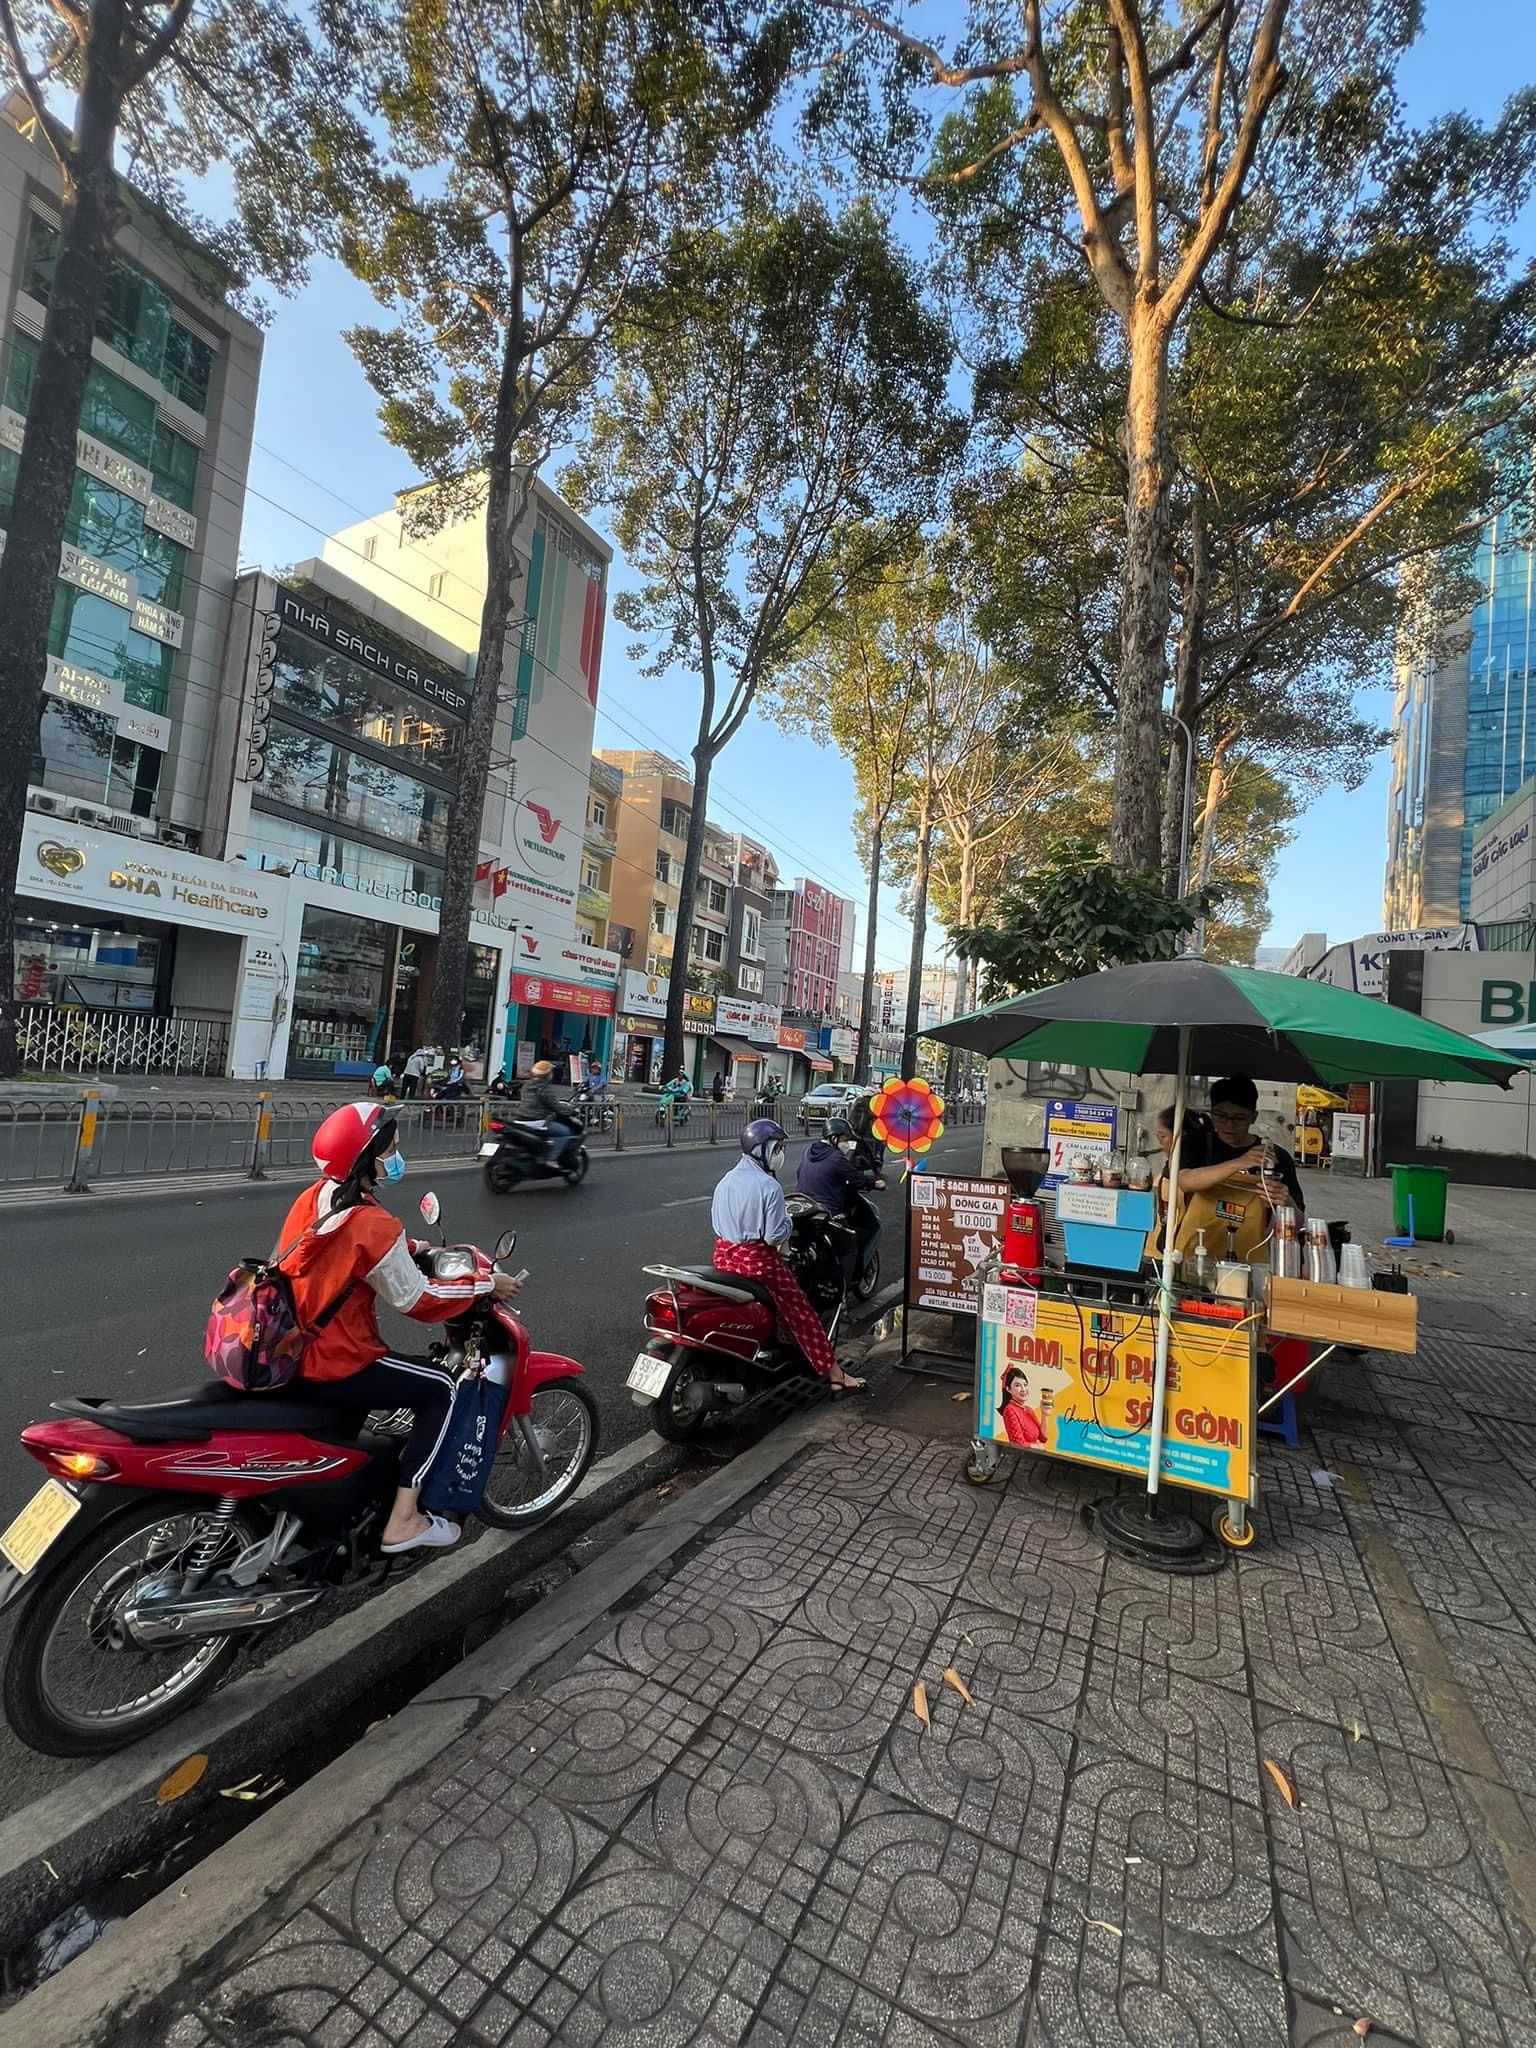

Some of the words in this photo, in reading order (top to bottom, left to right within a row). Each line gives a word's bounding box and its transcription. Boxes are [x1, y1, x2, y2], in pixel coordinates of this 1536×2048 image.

[284, 598, 329, 636] NHÀ
[335, 628, 389, 669] SÁCH
[424, 677, 466, 709] CHÉP
[109, 871, 162, 898] DHA
[172, 885, 269, 919] Healthcare
[947, 1181, 969, 1193] SẠCH
[971, 1183, 996, 1195] MANG
[960, 1214, 992, 1228] 10.000
[1006, 1332, 1062, 1370] LAM
[1082, 1343, 1116, 1378] CÀ
[1175, 1406, 1240, 1447] GÒN
